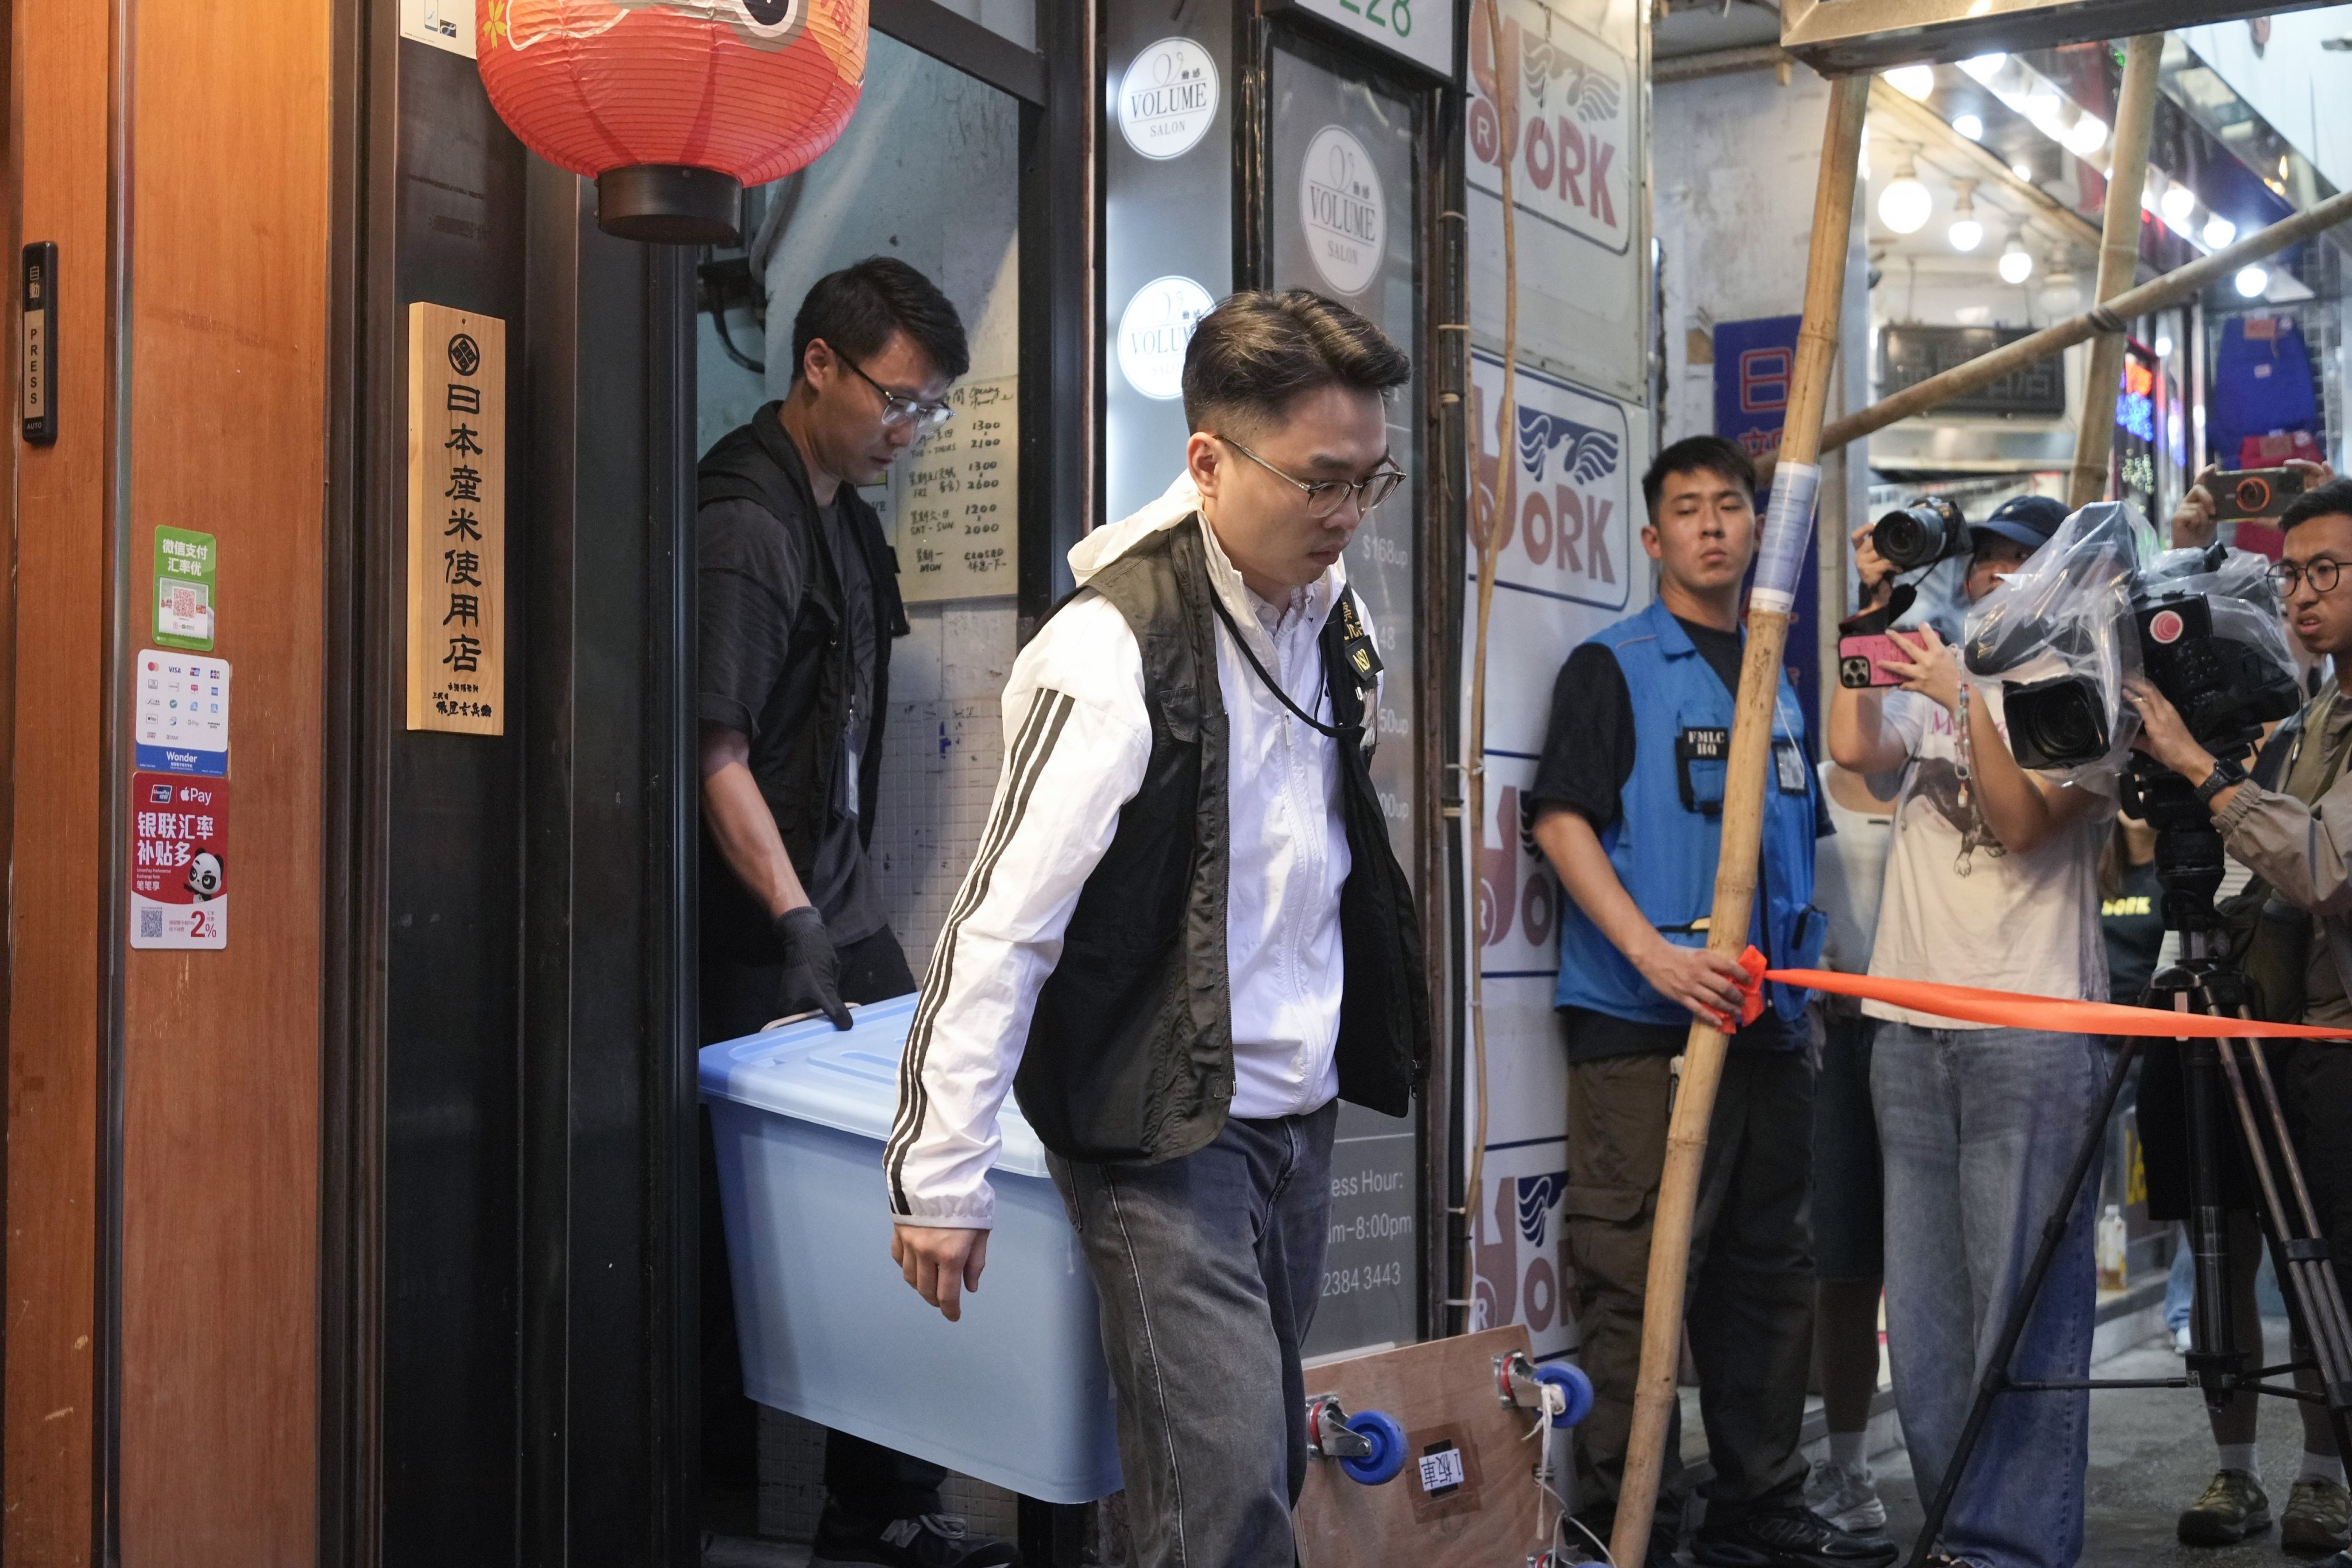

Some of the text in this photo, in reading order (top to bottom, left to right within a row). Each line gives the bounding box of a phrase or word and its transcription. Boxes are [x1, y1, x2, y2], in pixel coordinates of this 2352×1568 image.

[1131, 83, 1207, 118] VOLUME
[1150, 119, 1185, 137] SALON
[1310, 185, 1376, 241] VOLUME
[1327, 240, 1358, 264] SALON
[29, 265, 40, 299] 自動
[26, 422, 42, 430] AUTO
[972, 420, 1001, 430] 1300
[971, 439, 1001, 449] 2100
[968, 461, 998, 471] 1300
[913, 488, 928, 498] FRI
[967, 480, 999, 490] 2600
[965, 504, 997, 515] 1200
[910, 526, 925, 535] SAT
[936, 521, 954, 532] SUN
[964, 523, 999, 535] 2000
[163, 538, 208, 561] 微信支付
[168, 557, 202, 577] 汇率优
[920, 562, 942, 573] MON
[166, 751, 198, 763] Wonder
[190, 787, 212, 806] Pay
[137, 811, 214, 840] 银联汇率
[137, 840, 191, 867] 补贴多
[137, 880, 160, 891] 笔笔享
[191, 910, 217, 938] 2%
[1361, 1169, 1403, 1194] Hour:
[1322, 1262, 1401, 1296] 2384 3443
